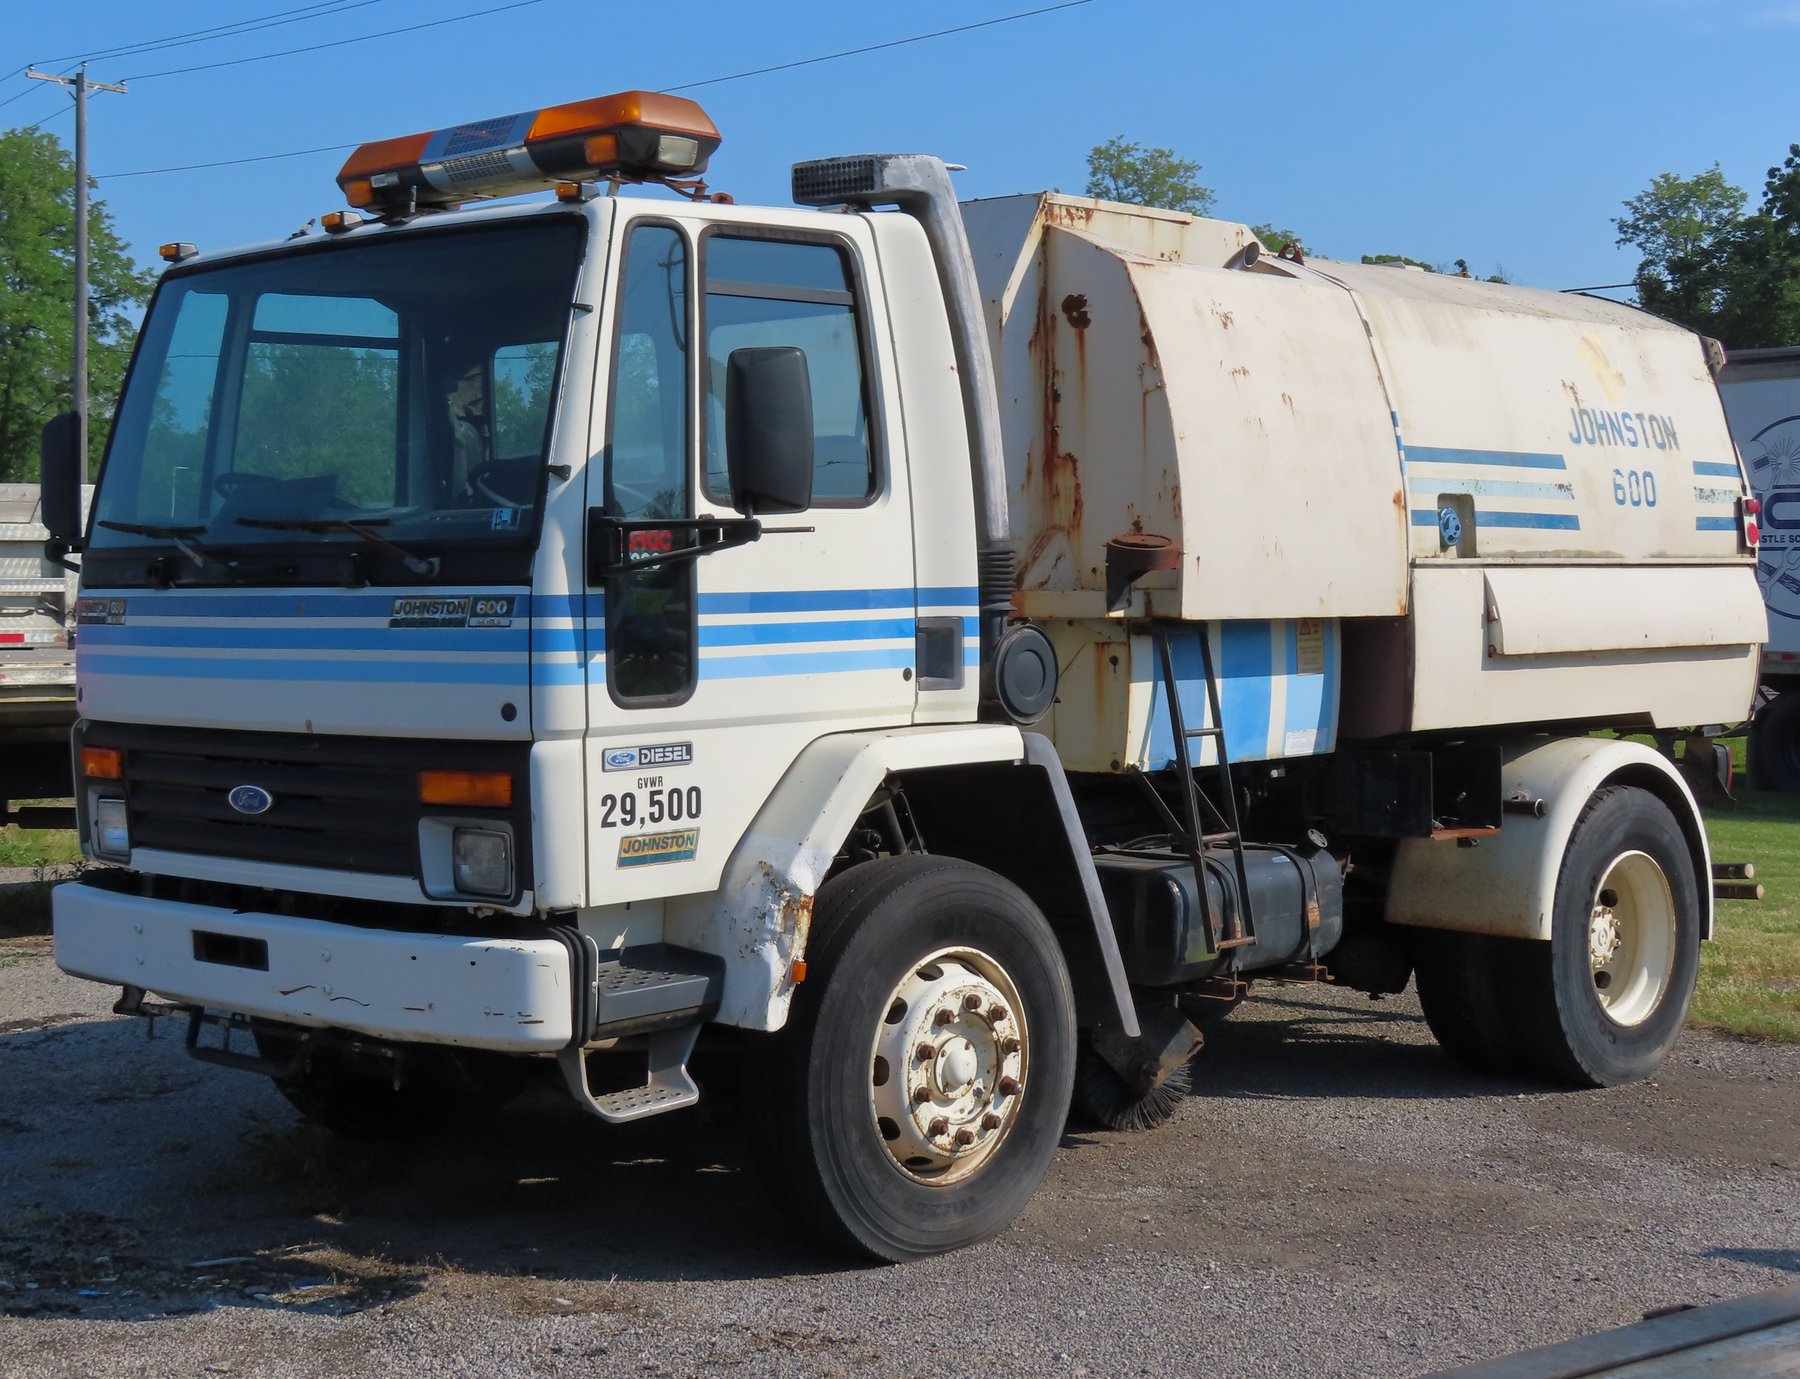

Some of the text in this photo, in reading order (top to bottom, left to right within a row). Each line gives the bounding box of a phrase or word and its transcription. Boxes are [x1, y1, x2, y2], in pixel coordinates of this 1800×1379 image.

[1568, 407, 1680, 452] JOHNSTON
[1613, 468, 1657, 508] 600
[1760, 534, 1786, 544] STLE
[393, 600, 508, 616] JOHNSTON 600
[640, 745, 692, 764] DIESEL
[637, 775, 664, 790] GVWR
[600, 785, 702, 831] 29,500
[622, 833, 696, 854] JOHNSTON
